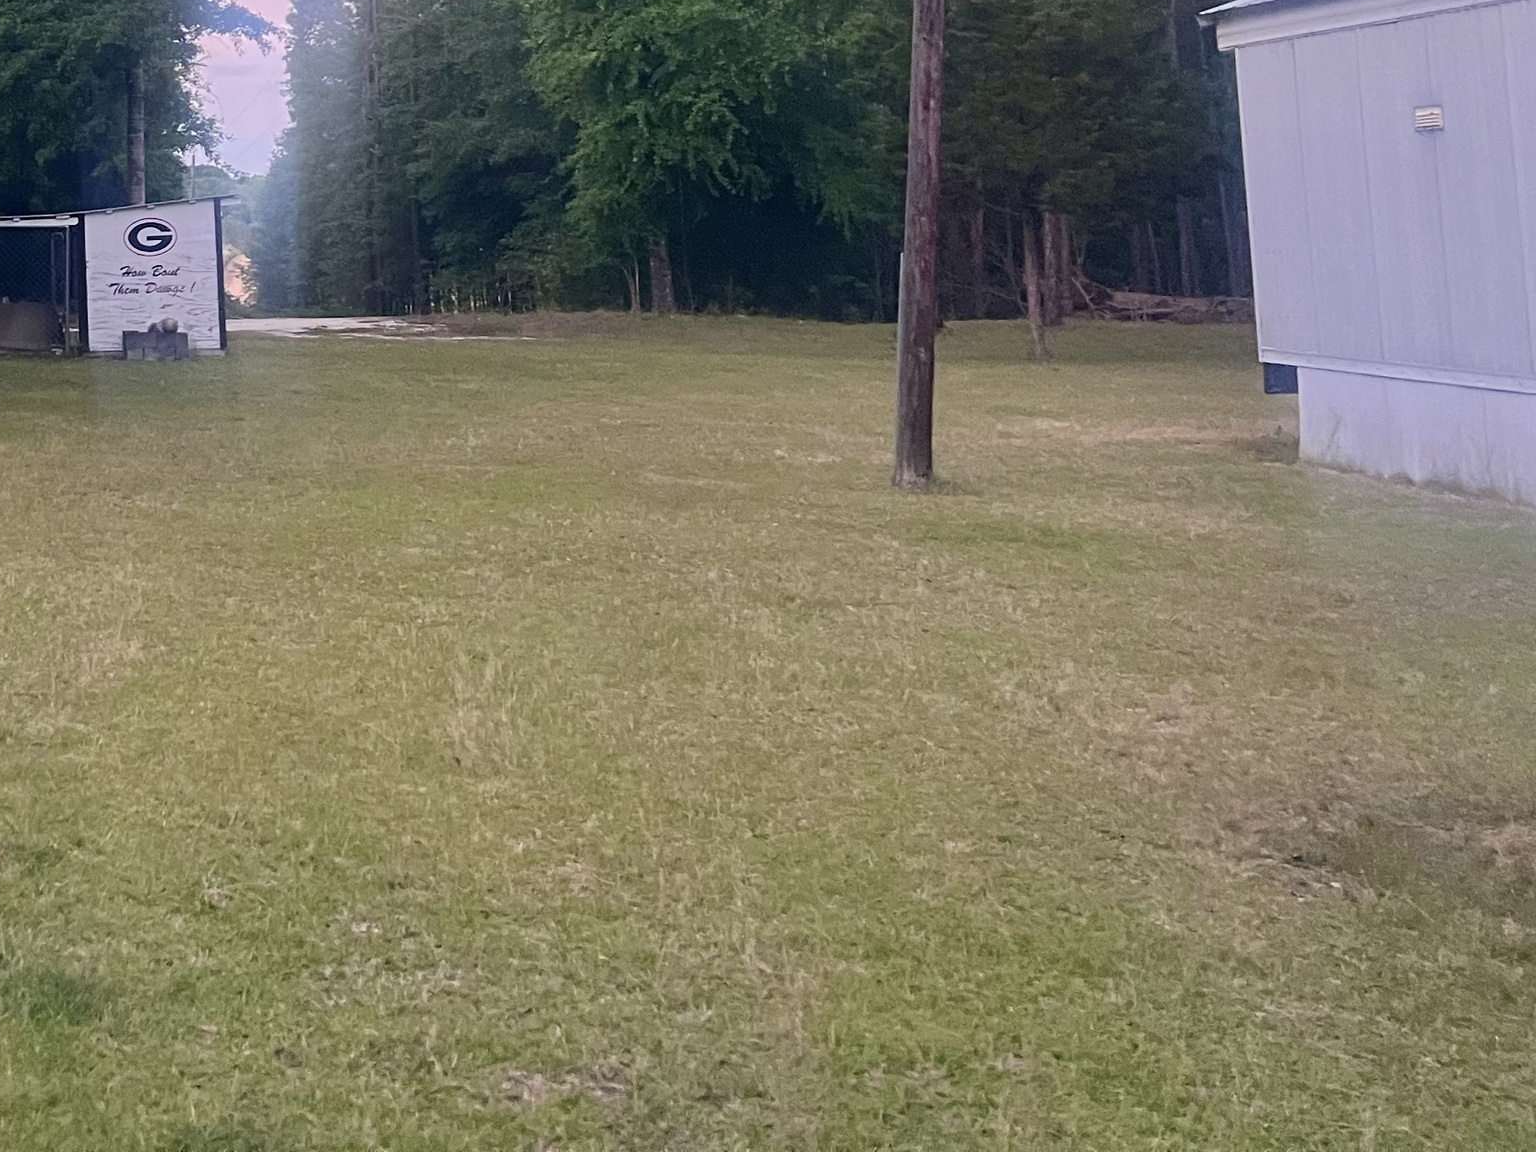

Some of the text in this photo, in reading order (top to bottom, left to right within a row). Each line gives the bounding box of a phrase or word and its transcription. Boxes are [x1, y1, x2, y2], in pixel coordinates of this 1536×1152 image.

[128, 221, 173, 252] G
[120, 265, 146, 277] How
[109, 282, 139, 295] Them
